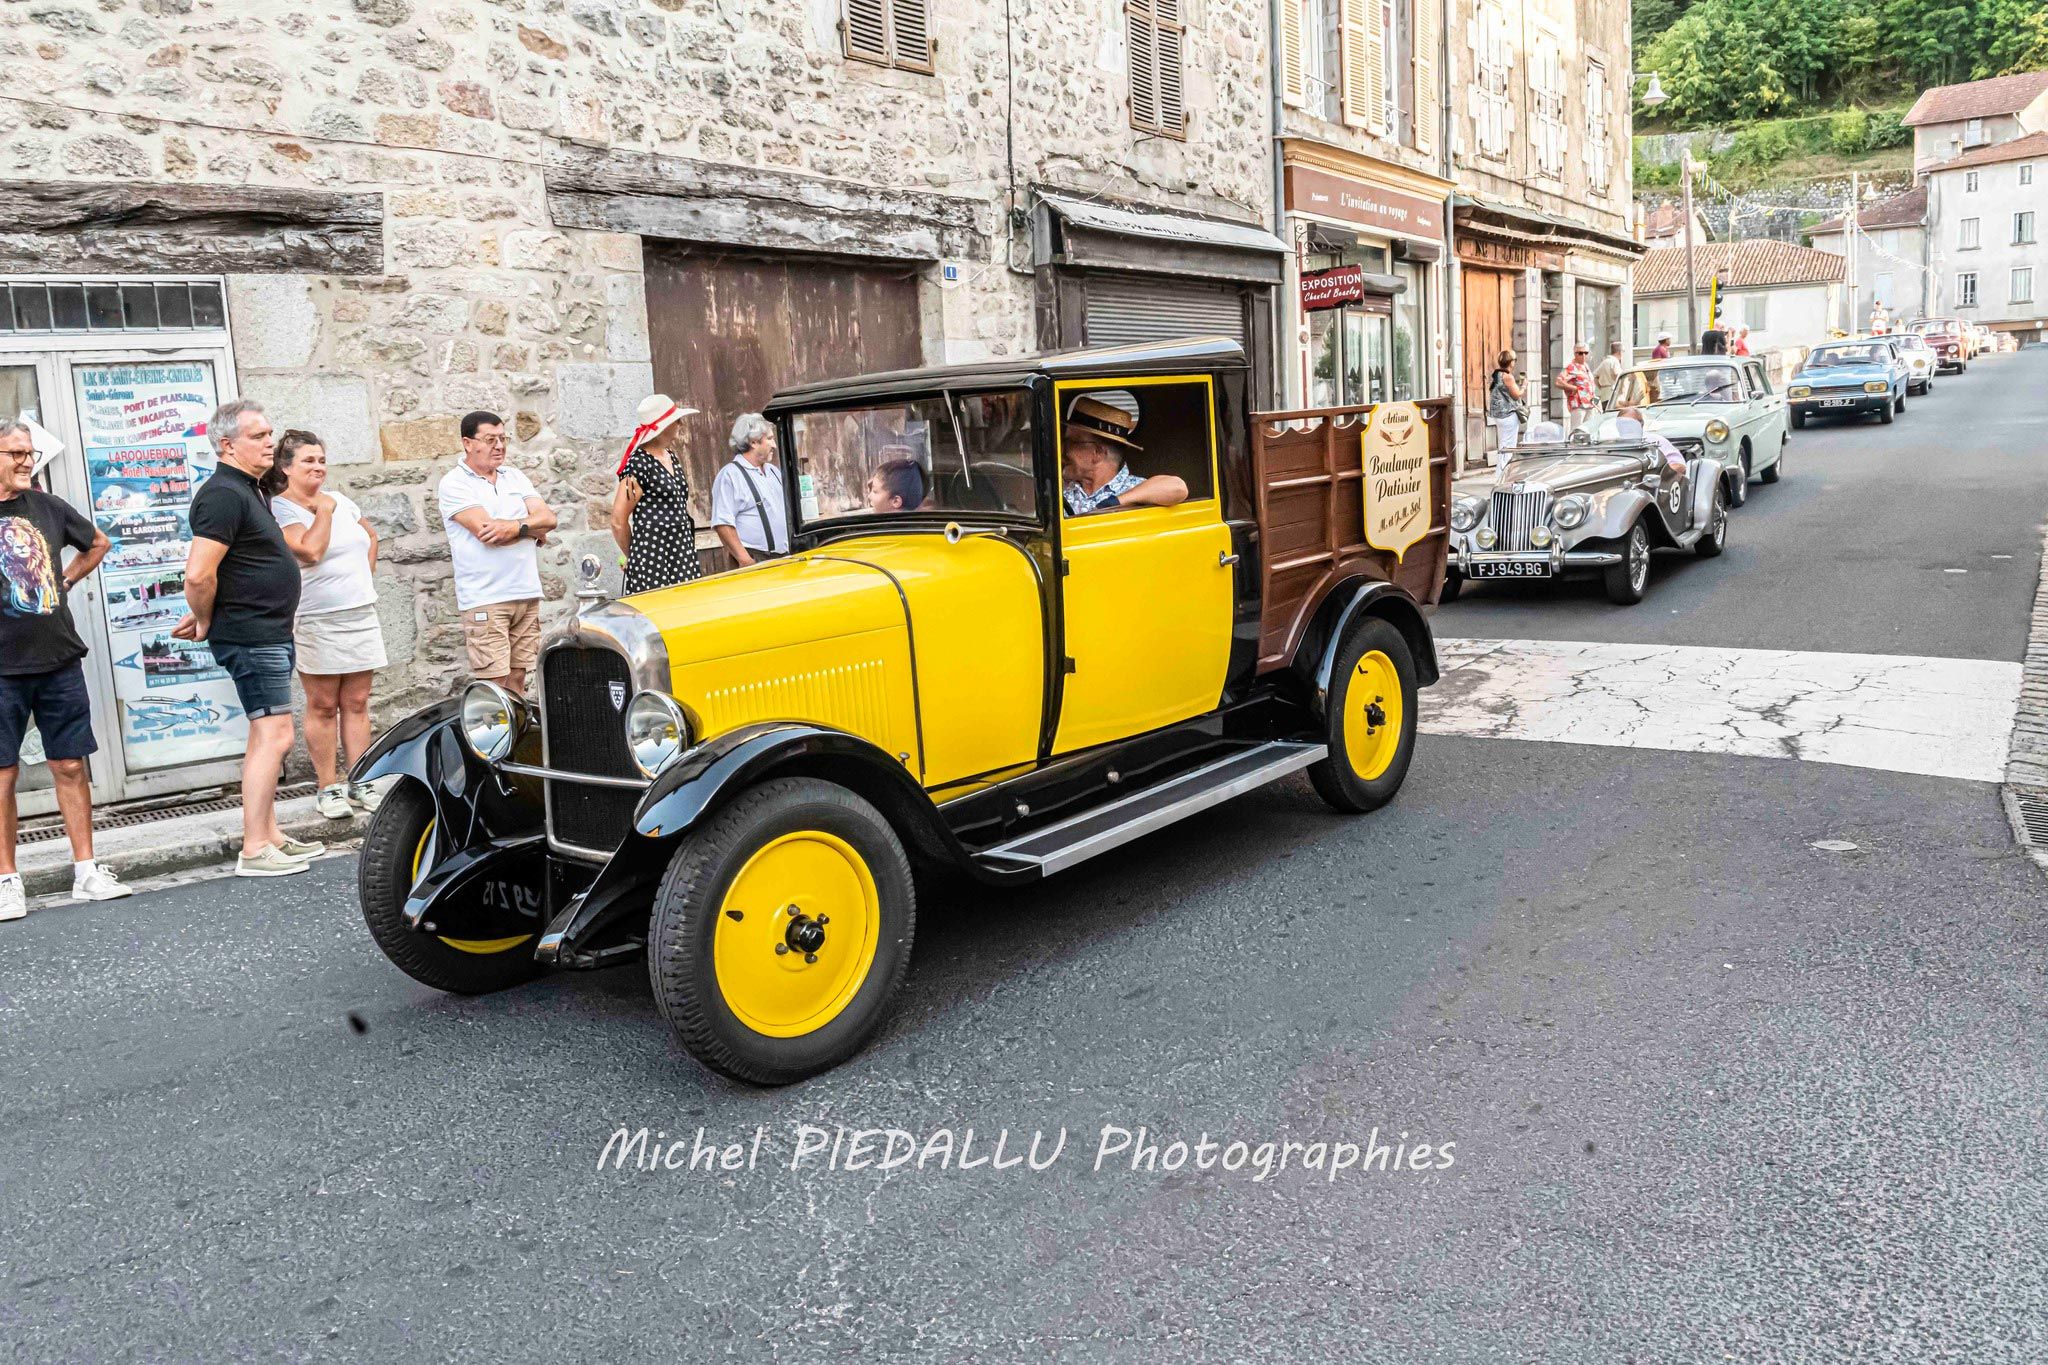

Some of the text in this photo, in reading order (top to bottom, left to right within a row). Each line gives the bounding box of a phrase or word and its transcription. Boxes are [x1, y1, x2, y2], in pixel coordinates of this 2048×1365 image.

[1341, 192, 1408, 222] L'invitation au voyage
[1302, 273, 1361, 290] EXPOSITION
[83, 371, 97, 386] LAC
[98, 371, 109, 385] DE
[124, 401, 145, 414] PORT
[148, 397, 158, 408] DE
[160, 392, 207, 407] PLAISANCE,
[138, 408, 181, 424] VACANCES,
[1383, 412, 1409, 425] Artisan
[108, 447, 183, 462] LAROQUEBROU
[145, 464, 186, 477] Restaurant
[1370, 453, 1423, 476] Boulanger
[1375, 477, 1422, 503] Patissier
[1671, 486, 1680, 508] 15
[122, 527, 131, 535] LE
[1479, 562, 1542, 576] FJ-949-BG
